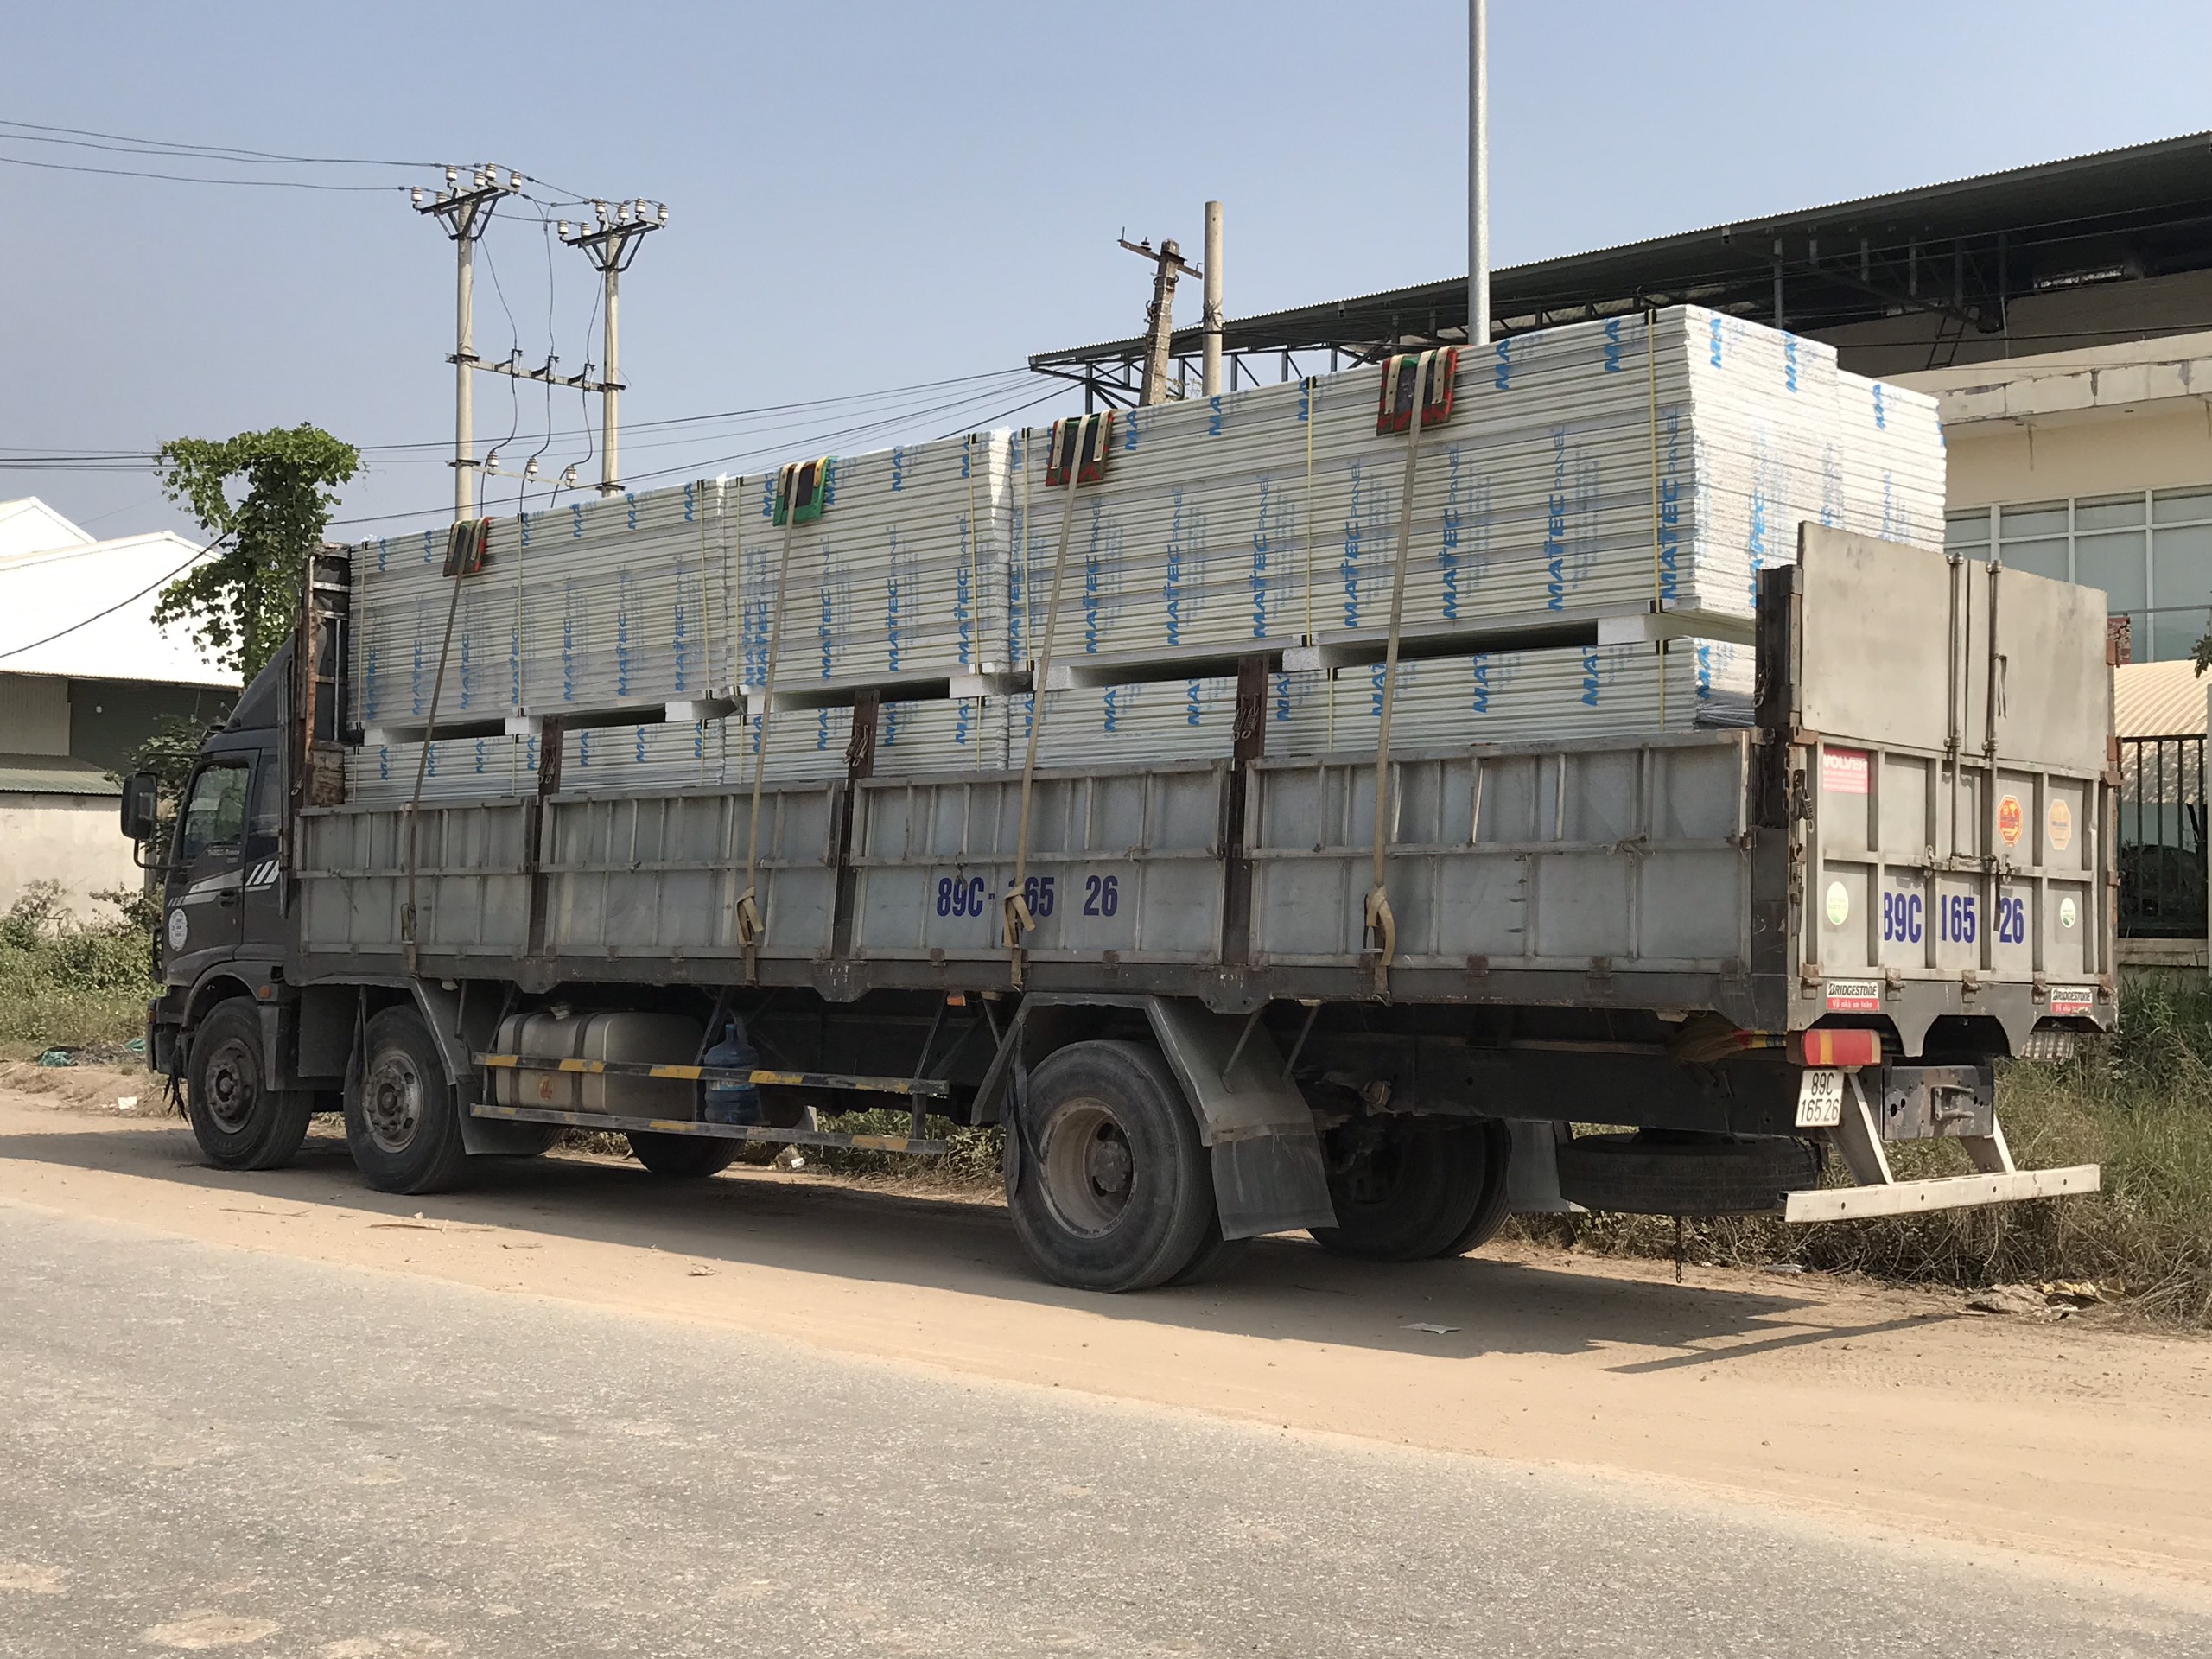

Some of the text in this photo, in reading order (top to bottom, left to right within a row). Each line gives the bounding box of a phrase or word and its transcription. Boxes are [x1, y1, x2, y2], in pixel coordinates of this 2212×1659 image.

[1165, 544, 1179, 645] MATEC
[1251, 533, 1268, 638] MATEC
[1343, 521, 1361, 627] MATEC
[1440, 509, 1459, 619] MATEC
[1546, 494, 1566, 611] MATEC
[887, 578, 899, 671] MATEC
[956, 568, 969, 664] MATEC
[1083, 875, 1119, 917] 26
[1884, 892, 2024, 944] 89C 165 26
[1828, 983, 1878, 996] BRIDGESTONE
[1801, 1098, 1840, 1122] 165.26
[1811, 1072, 1834, 1096] 89C
